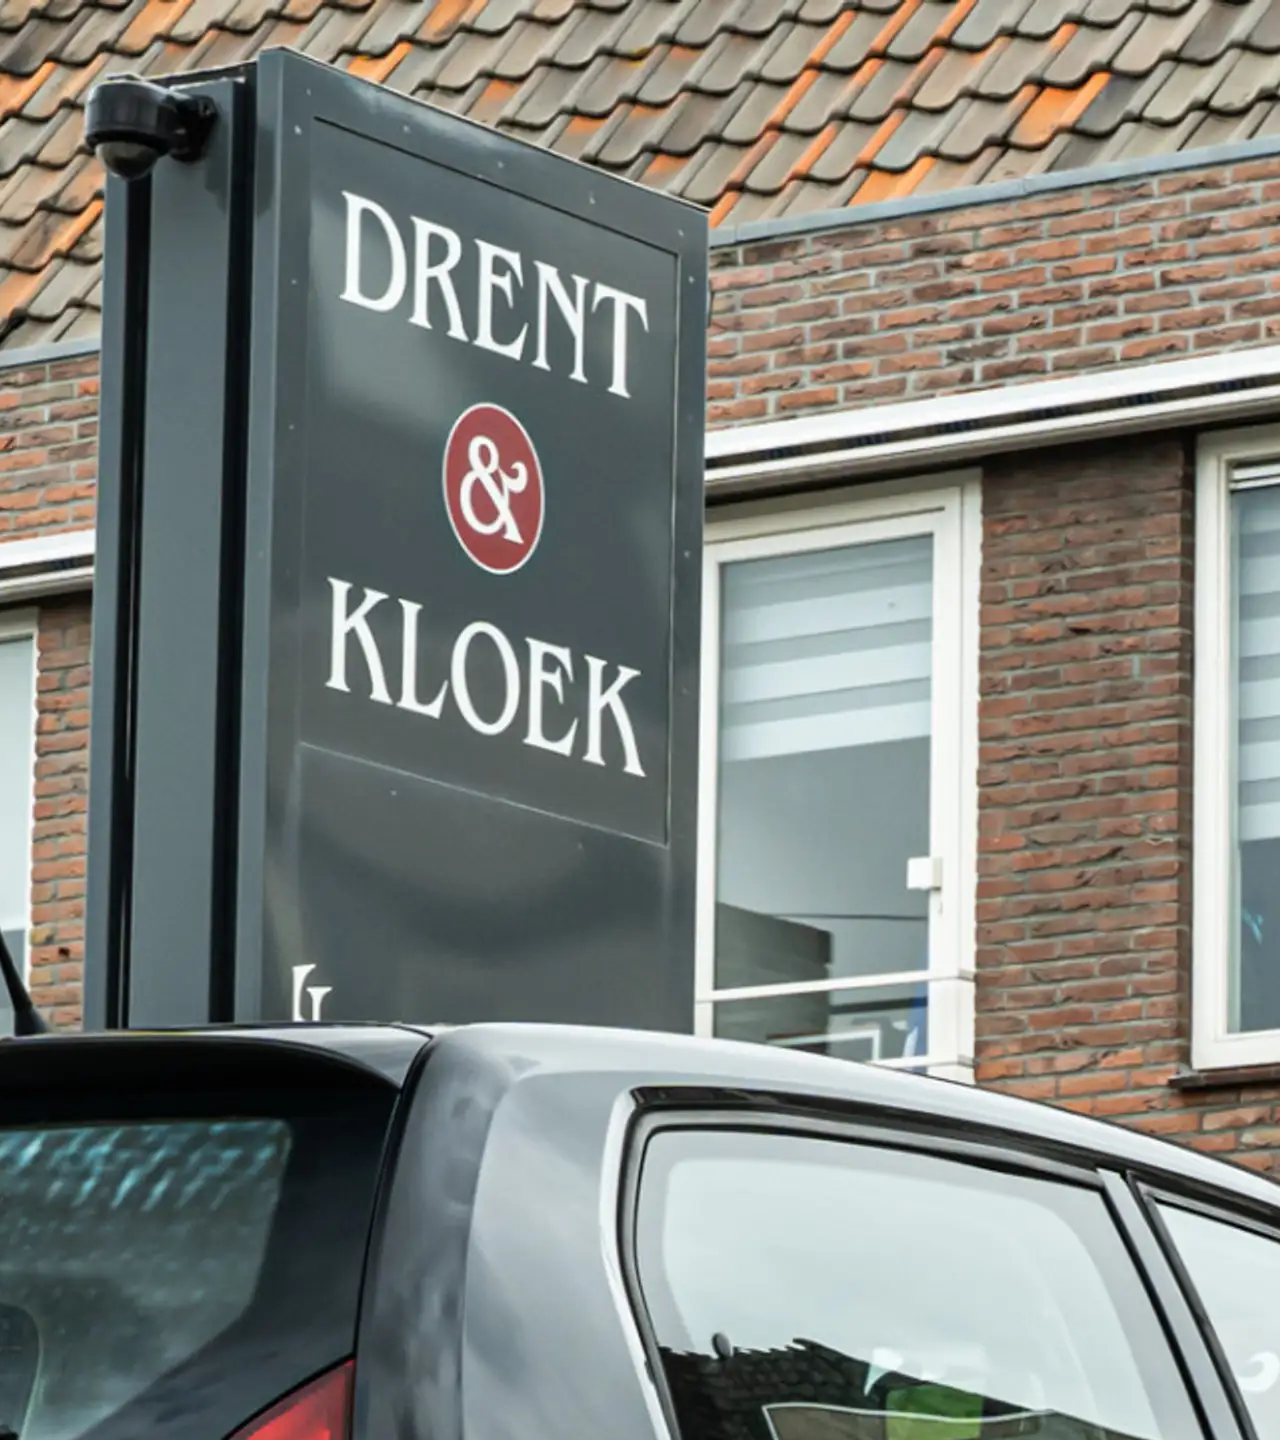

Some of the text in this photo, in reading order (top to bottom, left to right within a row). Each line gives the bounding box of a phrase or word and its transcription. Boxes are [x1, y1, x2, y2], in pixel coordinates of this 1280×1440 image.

[340, 190, 649, 398] DRENT
[460, 433, 528, 545] &
[326, 577, 646, 777] KLOEK
